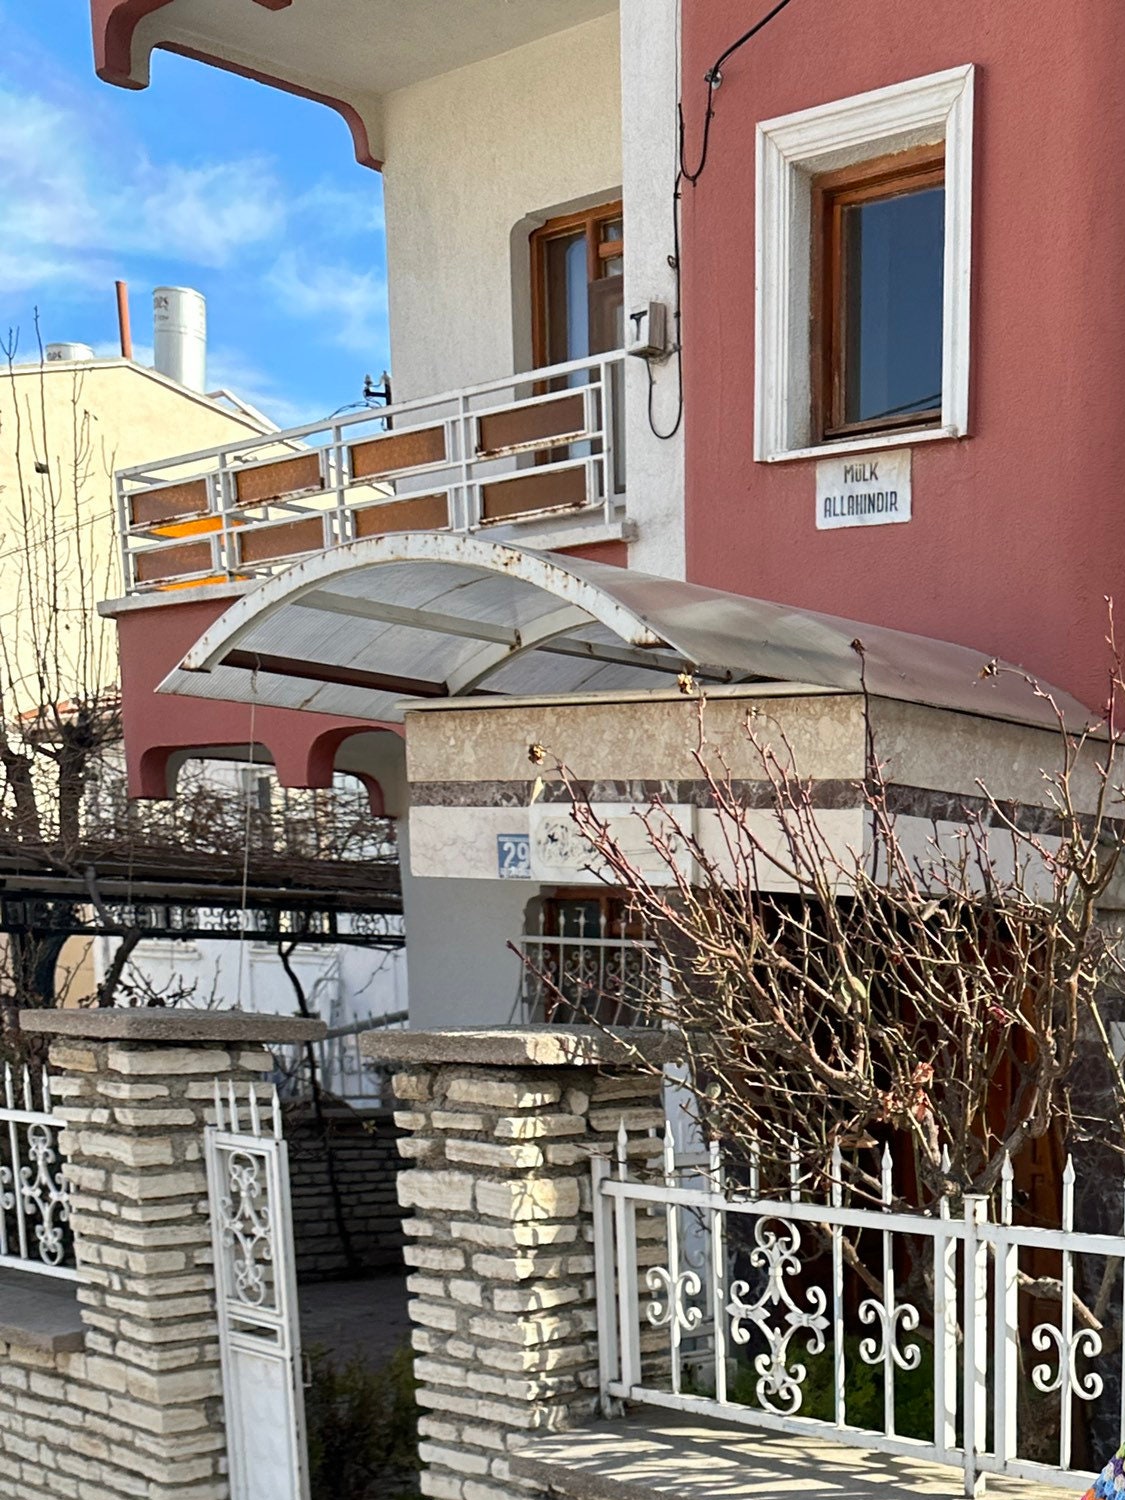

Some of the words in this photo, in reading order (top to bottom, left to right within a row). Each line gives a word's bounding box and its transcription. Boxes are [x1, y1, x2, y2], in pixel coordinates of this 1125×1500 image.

[844, 461, 879, 484] MÜLK
[824, 491, 898, 518] ALLAHINDIR
[503, 842, 529, 869] 29
